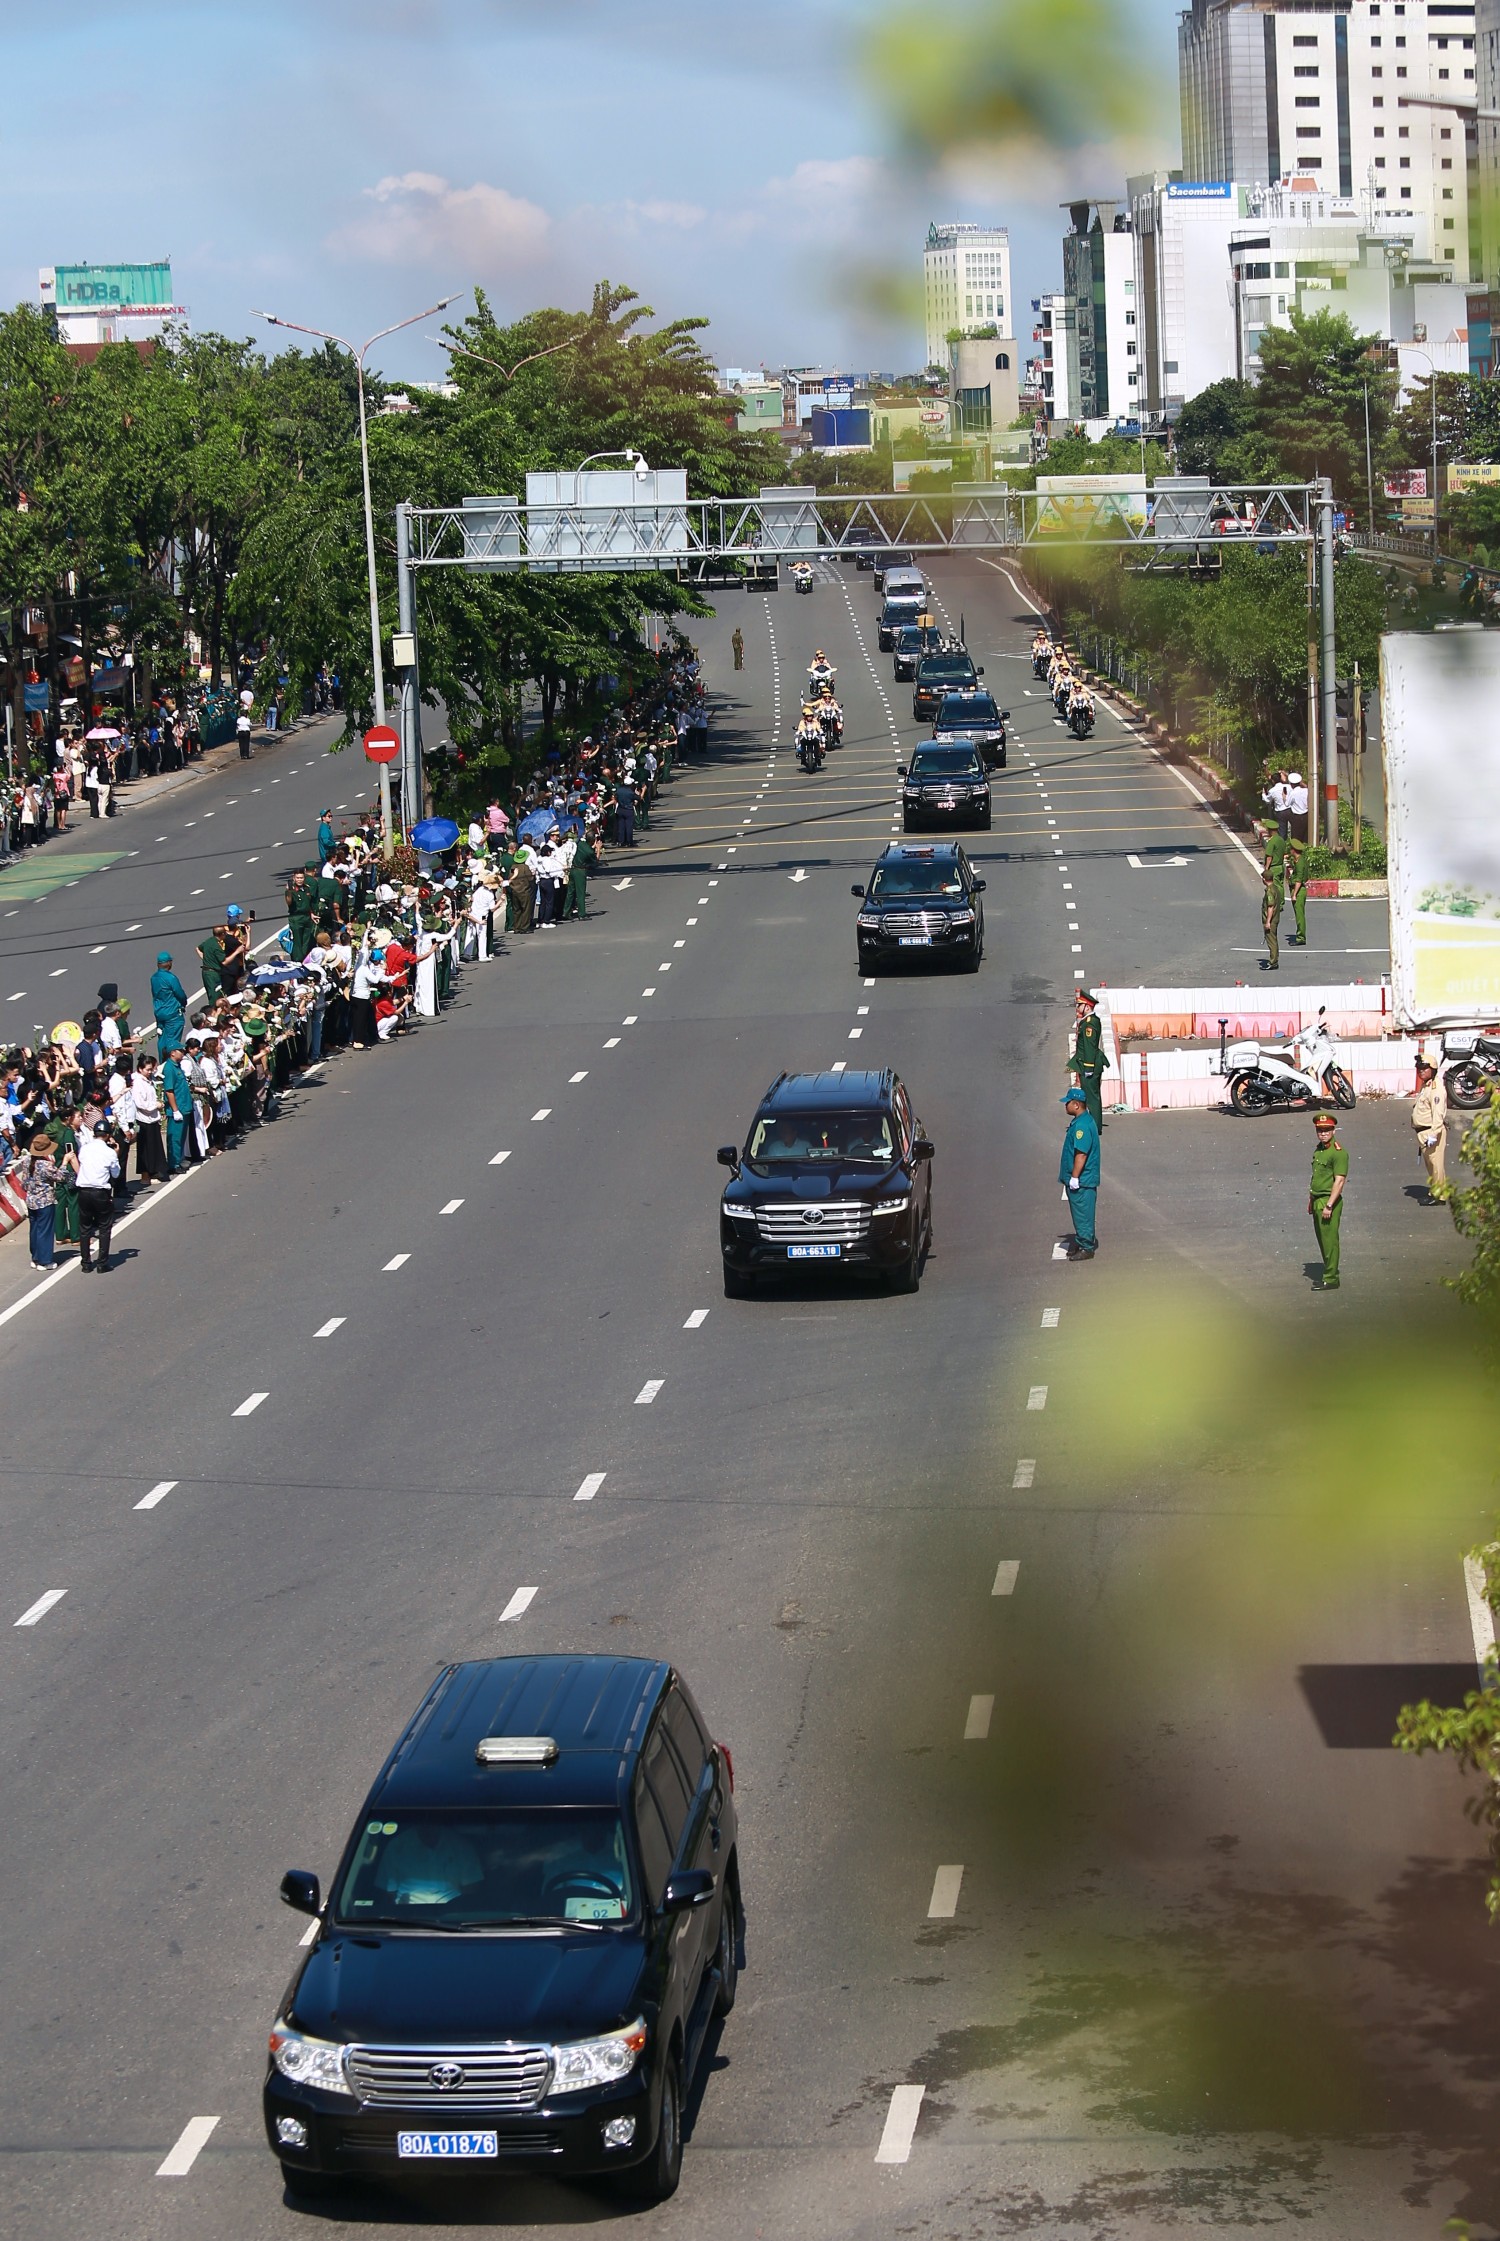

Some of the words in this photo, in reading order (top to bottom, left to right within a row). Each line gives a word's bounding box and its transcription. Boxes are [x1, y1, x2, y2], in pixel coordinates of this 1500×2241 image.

[1169, 185, 1226, 196] Sacombank
[1456, 467, 1471, 476] KÍNH
[1472, 468, 1480, 476] XE
[1481, 467, 1492, 476] HƠI
[593, 1909, 608, 1919] 02
[401, 2135, 494, 2154] 80A-018.76
